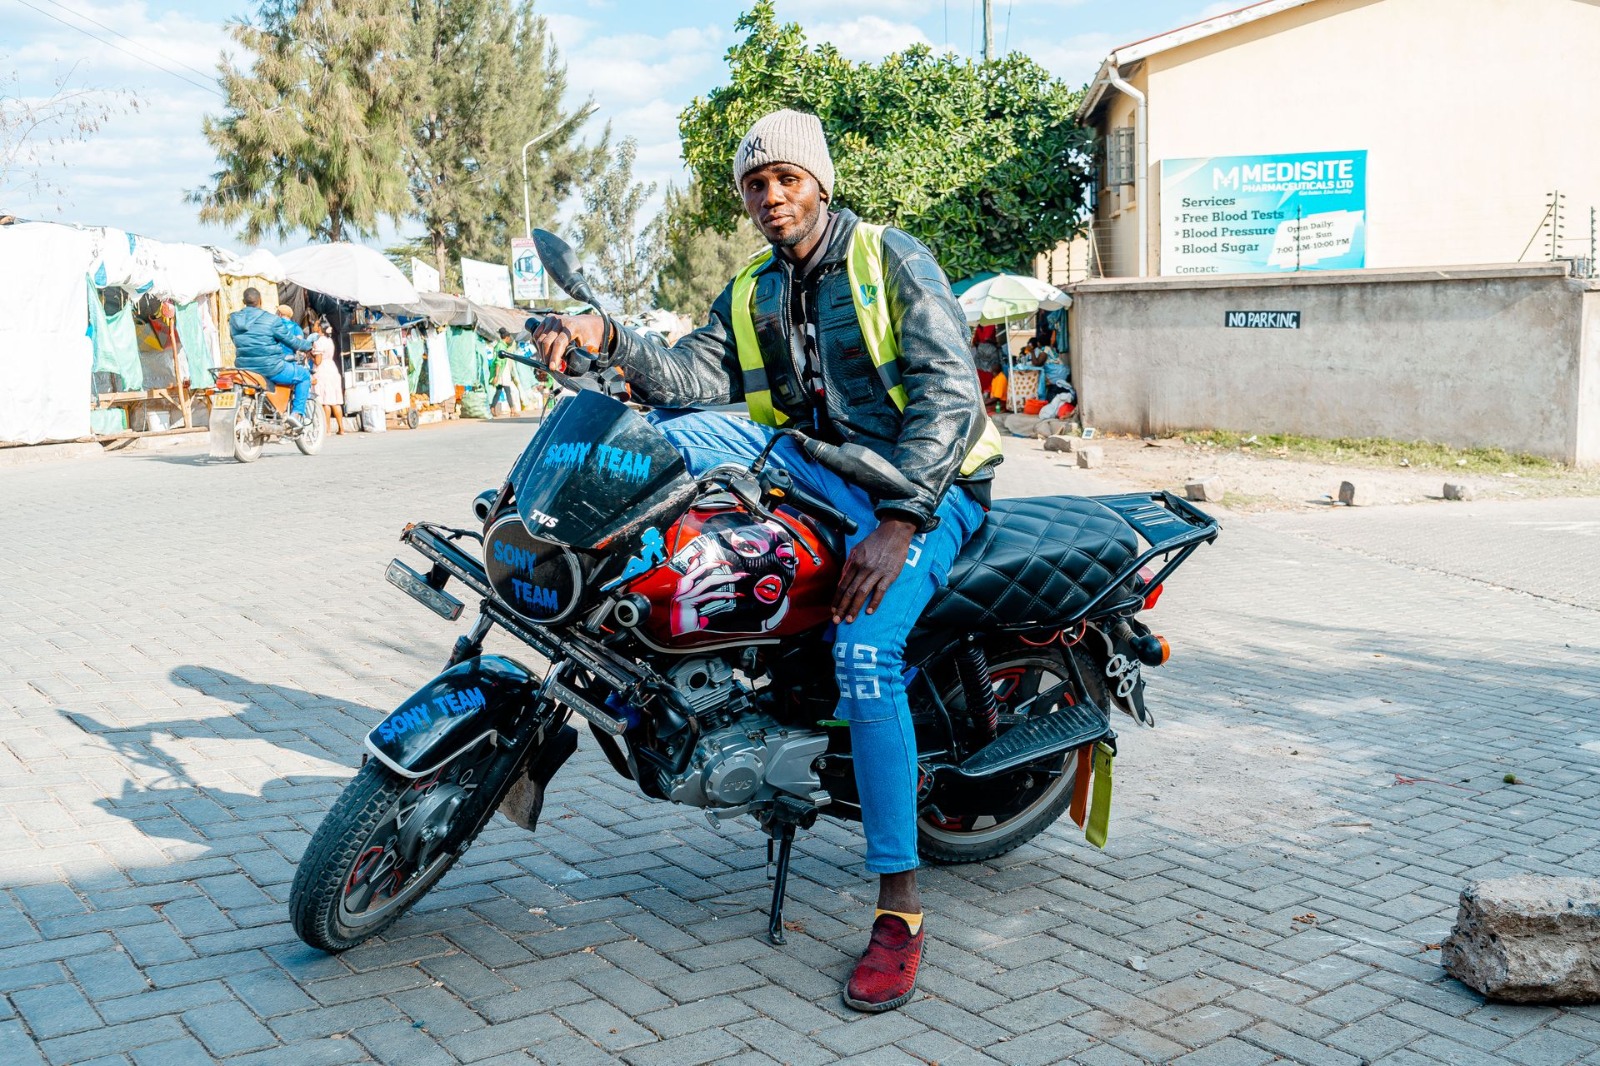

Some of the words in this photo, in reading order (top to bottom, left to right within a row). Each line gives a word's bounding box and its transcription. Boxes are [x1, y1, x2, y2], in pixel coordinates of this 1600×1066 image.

[1242, 159, 1354, 183] MEDISITE
[1242, 181, 1335, 193] PHARMACEUTICALS
[1336, 179, 1355, 189] LTD
[1181, 196, 1236, 207] Services
[1182, 213, 1208, 223] Free
[1212, 210, 1248, 222] Blood
[1251, 210, 1285, 220] Tests
[1310, 220, 1334, 230] Daily:
[1182, 227, 1218, 239] Blood
[1221, 227, 1276, 237] Pressure
[1315, 231, 1333, 239] Sun
[1182, 243, 1218, 254] Blood
[1221, 242, 1260, 255] Sugar
[1276, 246, 1294, 254] 7:00
[1336, 238, 1350, 246] PM
[1175, 265, 1219, 274] Contact:
[1228, 312, 1246, 327] NO
[1247, 312, 1298, 329] PARKING
[543, 441, 592, 470] SONY
[595, 443, 652, 483] TEAM
[530, 509, 560, 528] TVS
[493, 539, 537, 577] SONY
[511, 577, 559, 612] TEAM
[378, 702, 433, 743] SONY
[432, 686, 487, 717] TEAM
